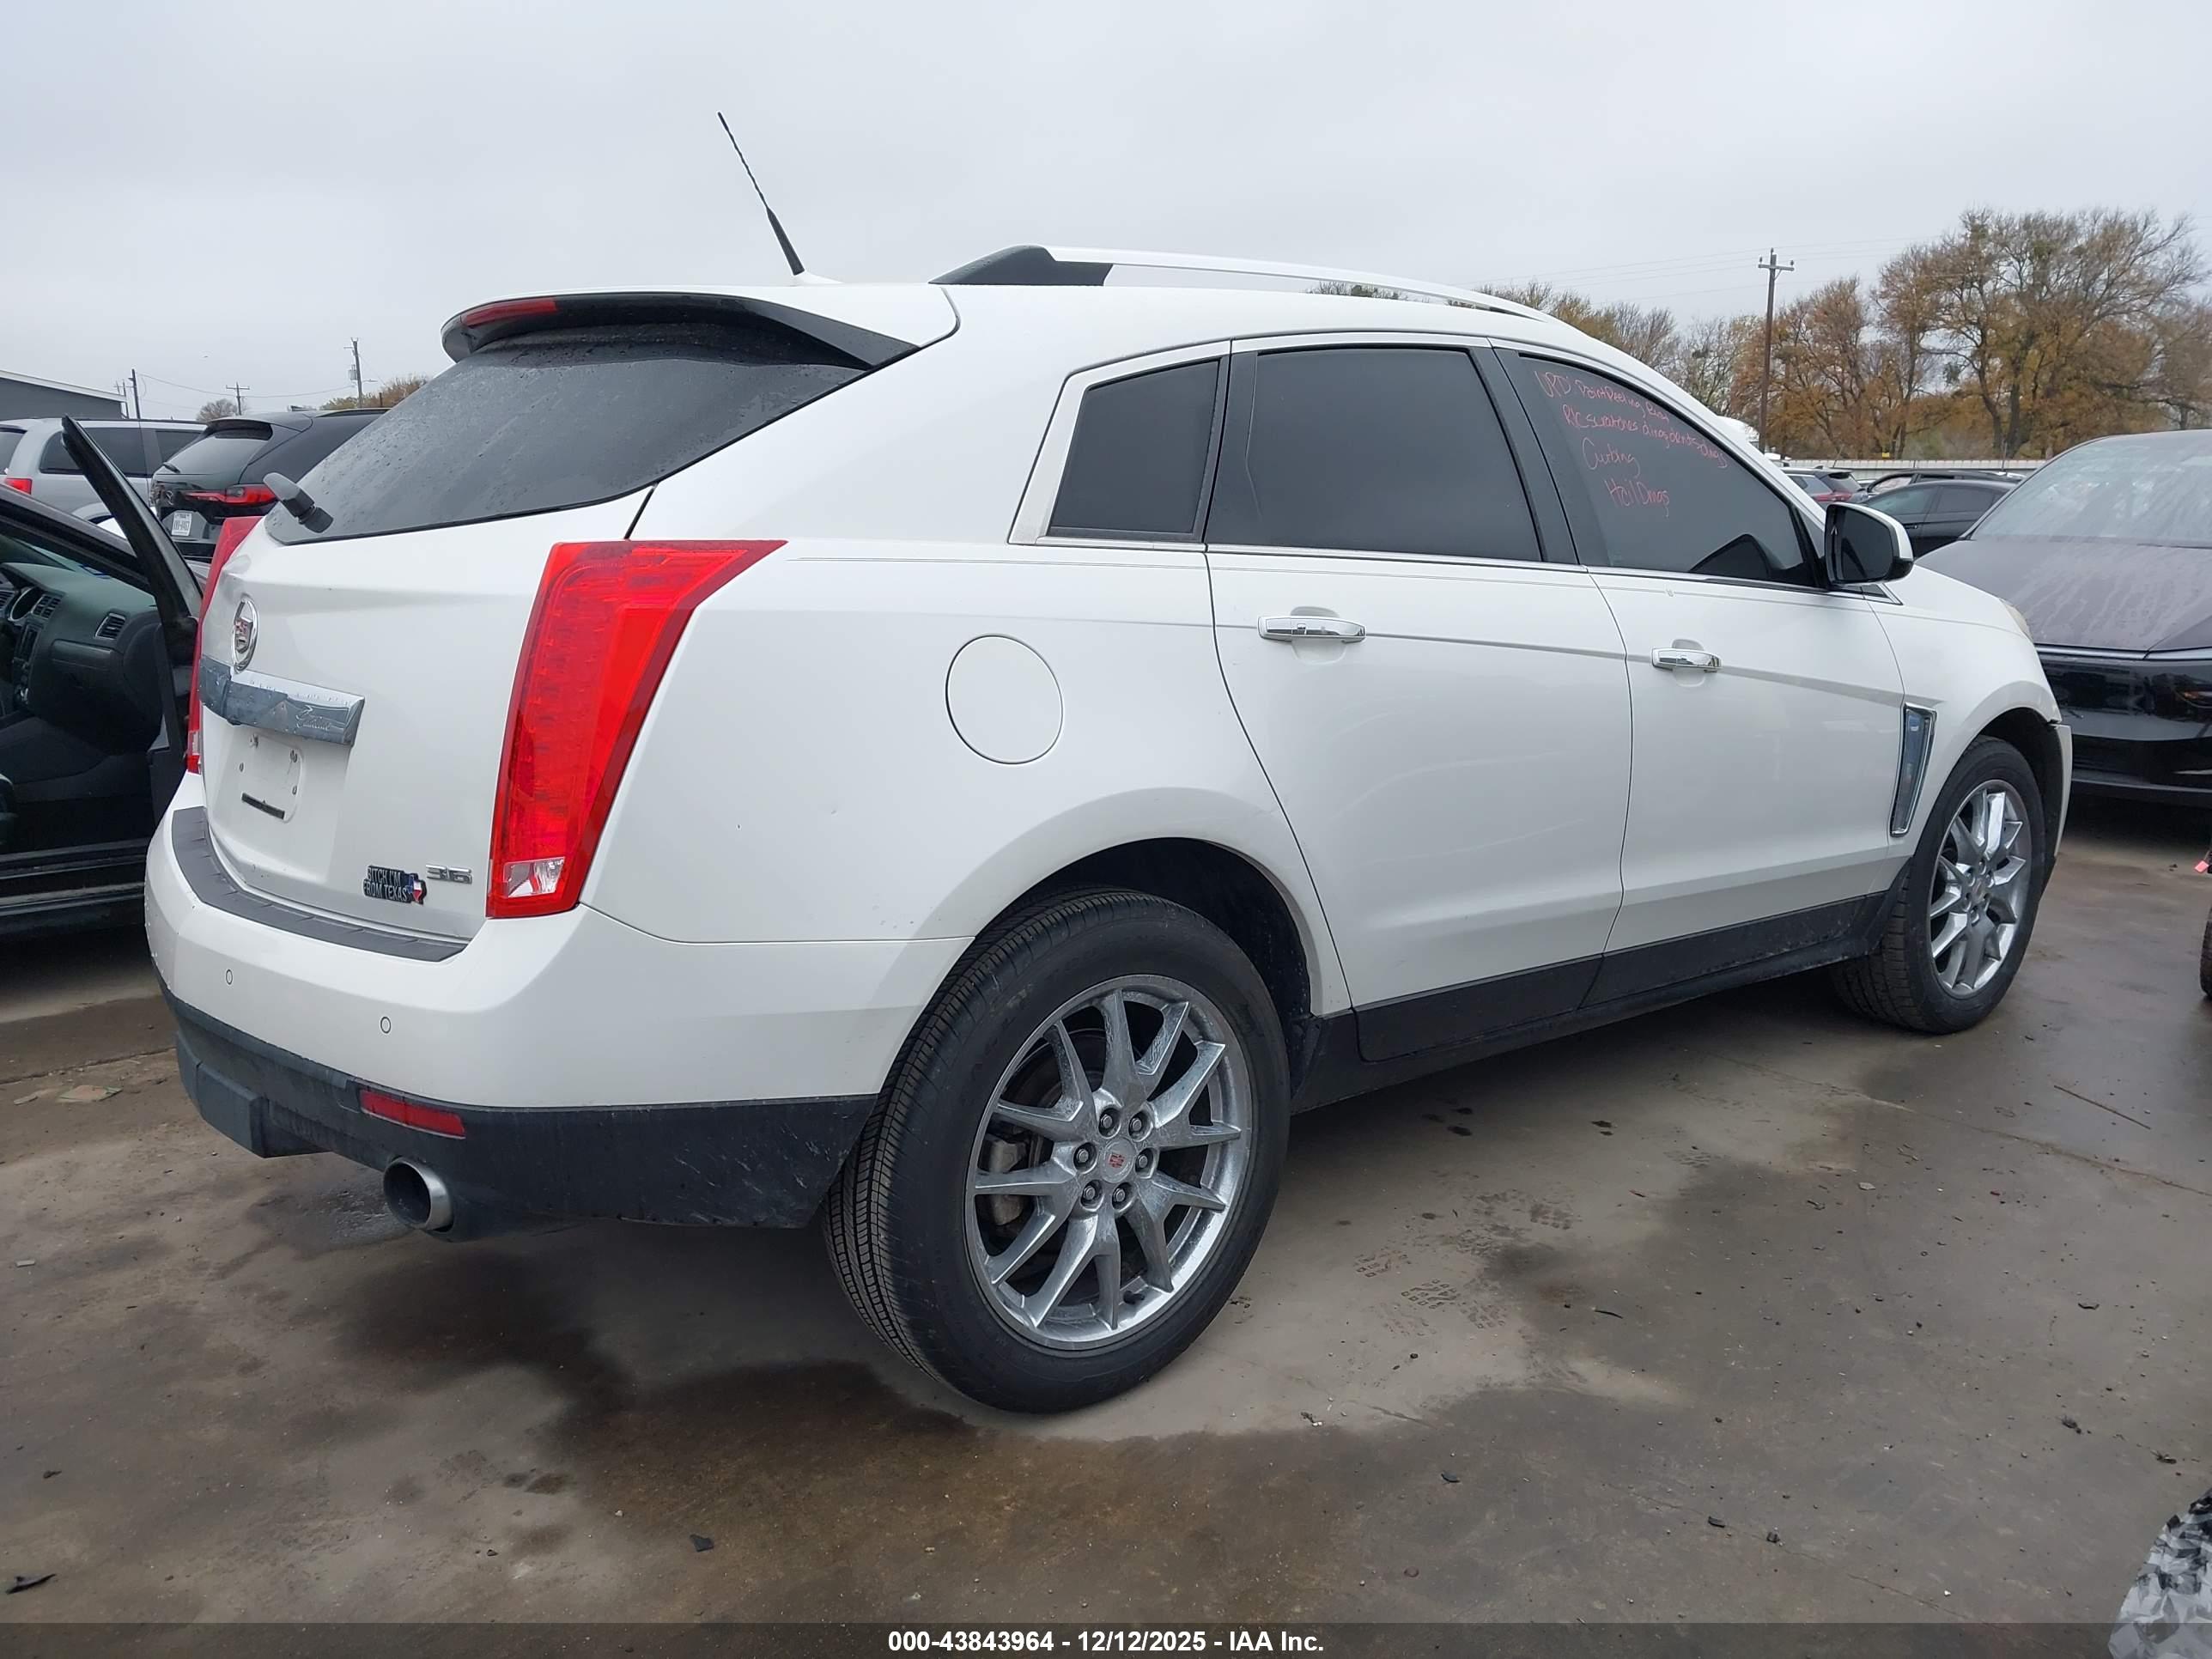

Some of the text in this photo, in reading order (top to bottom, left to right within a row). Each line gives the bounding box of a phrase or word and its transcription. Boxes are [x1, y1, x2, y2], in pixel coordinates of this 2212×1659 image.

[367, 867, 401, 886] BITCH I'M
[363, 880, 408, 902] FROM TEXAS
